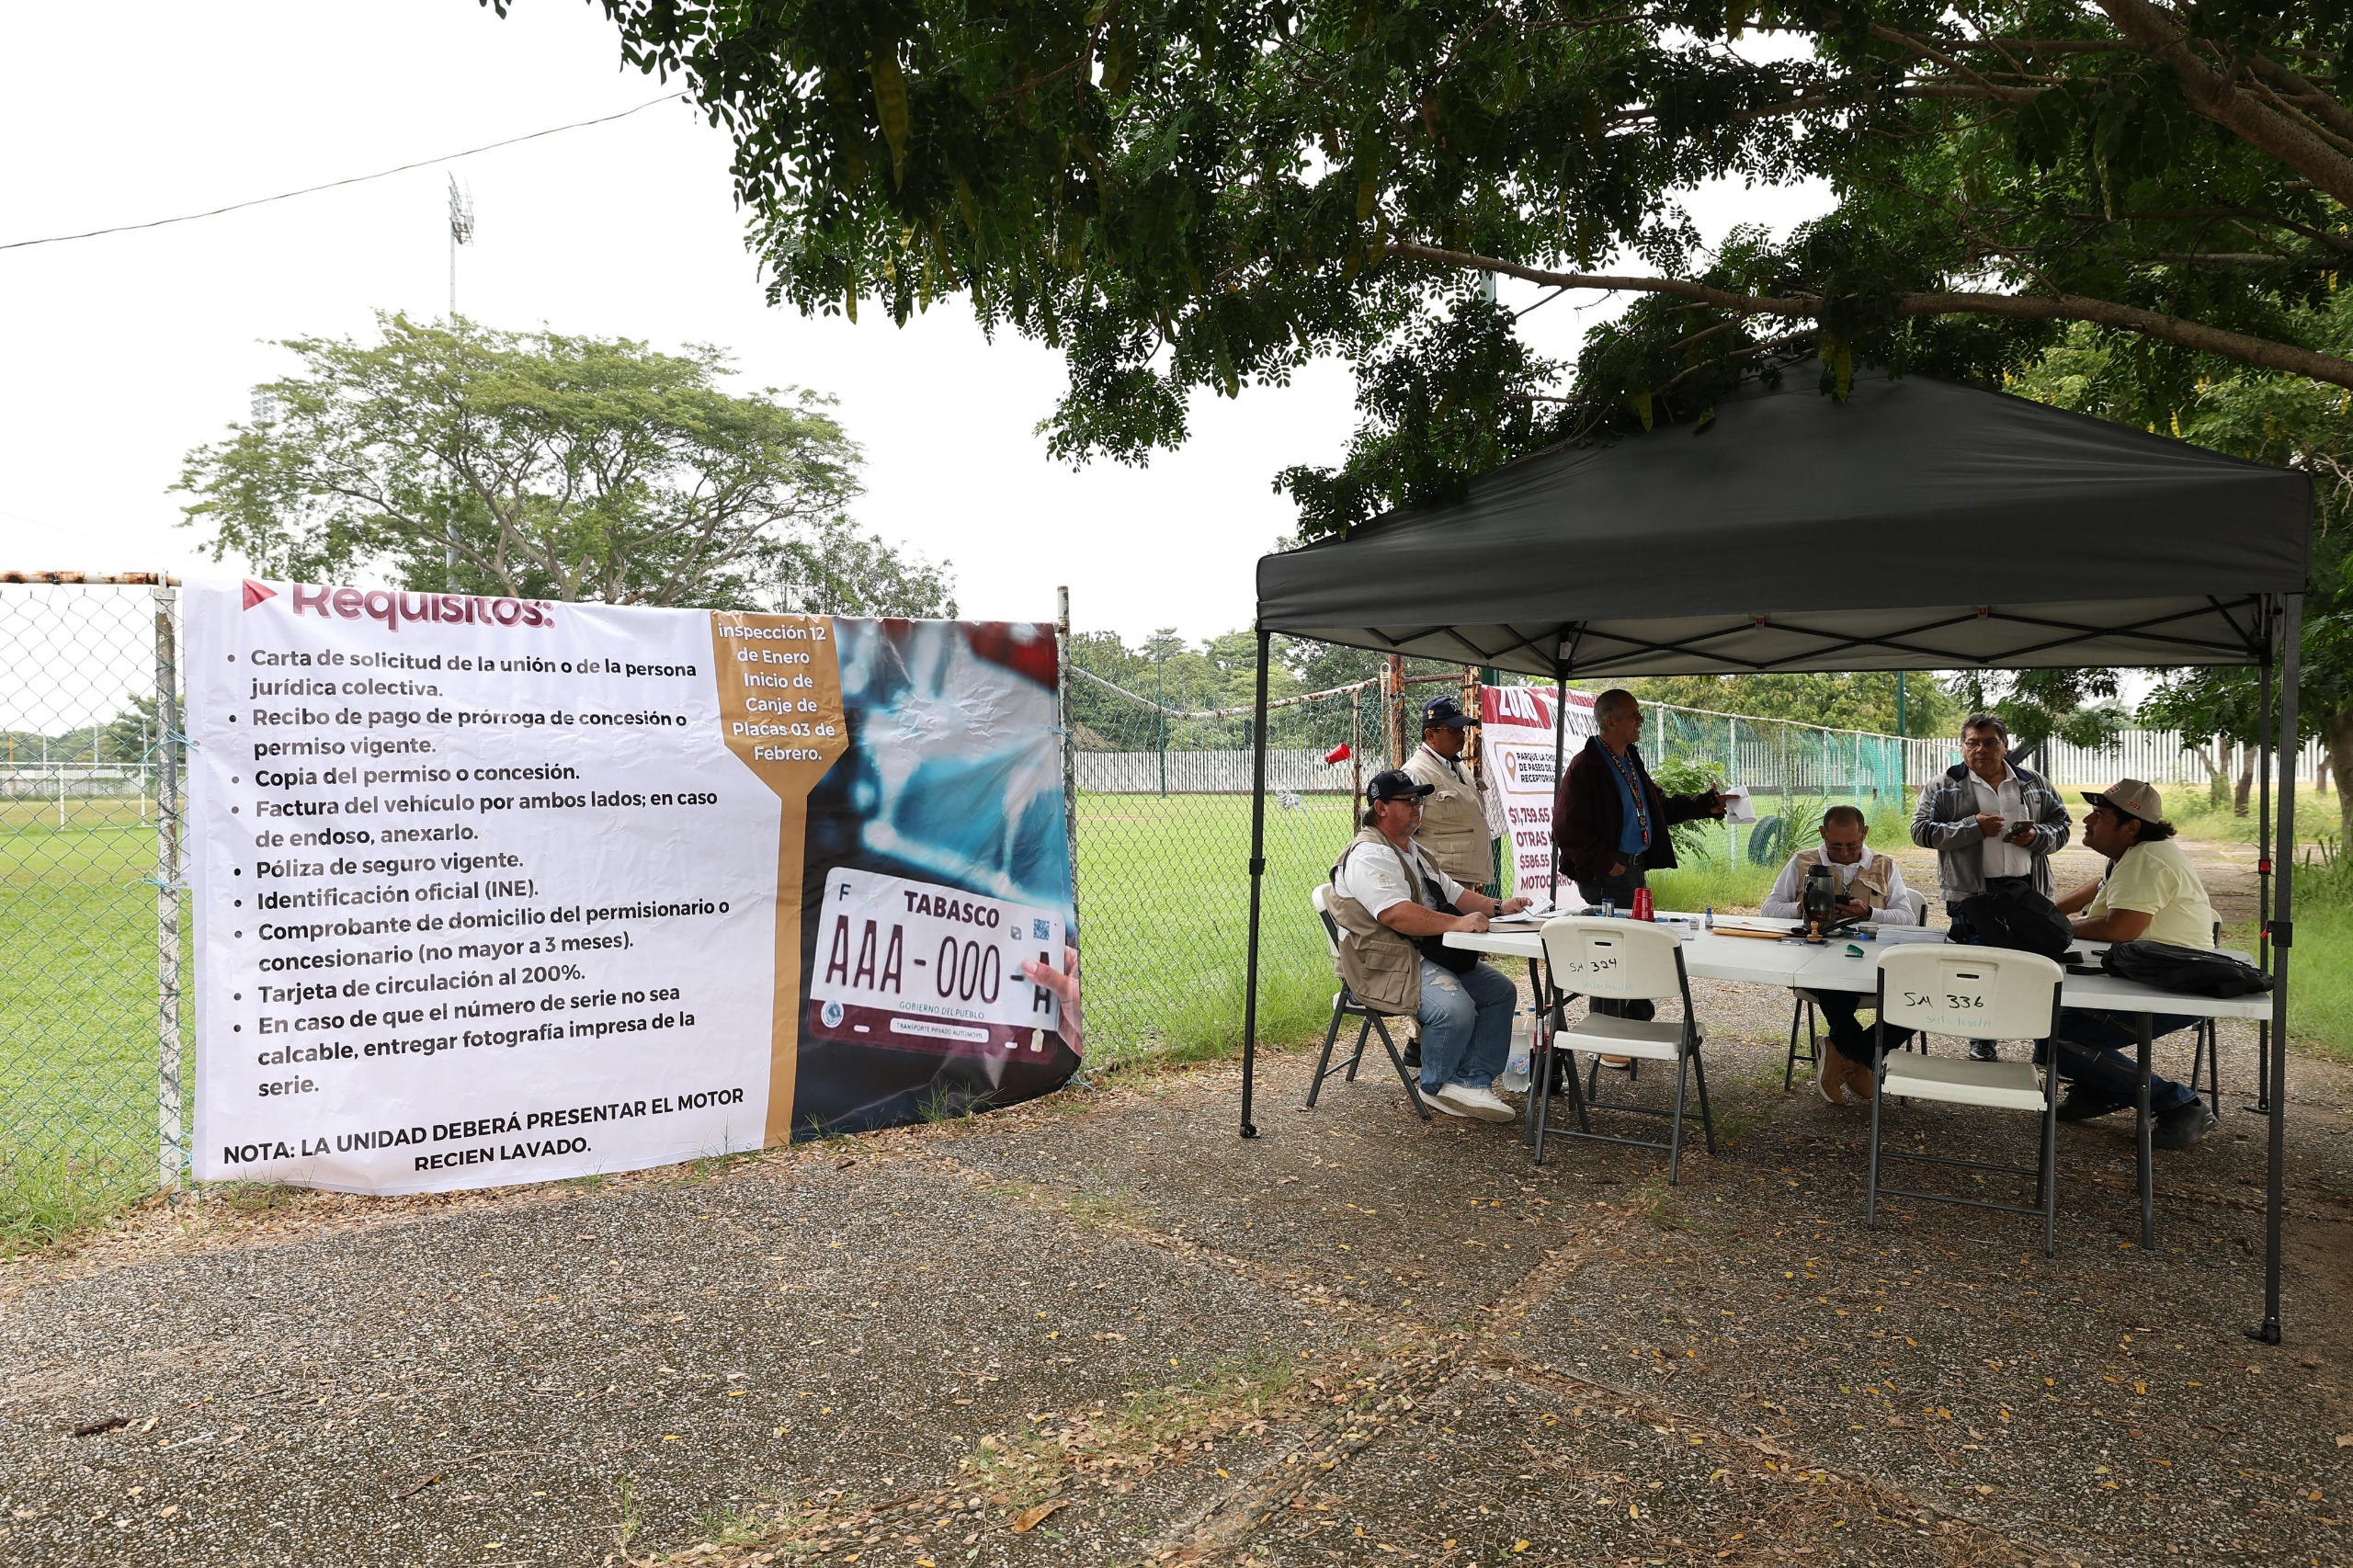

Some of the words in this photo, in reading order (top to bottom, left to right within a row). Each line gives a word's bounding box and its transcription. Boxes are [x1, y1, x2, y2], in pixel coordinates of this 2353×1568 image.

[292, 584, 555, 632] Requisitos:
[719, 622, 807, 640] inspección
[810, 627, 825, 640] 12
[252, 650, 311, 665] Carta
[317, 649, 344, 665] de
[350, 652, 441, 670] solicitud
[448, 655, 472, 670] de
[478, 656, 494, 671] la
[501, 656, 555, 672] unión
[562, 663, 572, 673] o
[577, 659, 600, 674] de
[606, 658, 620, 673] la
[626, 664, 696, 677] persona
[737, 647, 757, 661] de
[763, 650, 809, 664] Enero
[250, 677, 335, 699] jurídica
[342, 678, 442, 697] colectiva.
[745, 672, 788, 687] Inicio
[793, 674, 813, 687] de
[746, 698, 791, 714] Canje
[798, 699, 816, 711] de
[254, 708, 329, 725] Recibo
[335, 708, 362, 724] de
[369, 711, 421, 728] pago
[426, 708, 452, 723] de
[459, 710, 545, 728] prórroga
[551, 710, 574, 725] de
[579, 710, 671, 725] concesión
[676, 716, 687, 726] o
[733, 722, 787, 735] Placas
[790, 711, 812, 736] 03
[815, 723, 835, 735] de
[255, 737, 345, 760] permiso
[350, 736, 436, 757] vigente.
[755, 745, 822, 760] Febrero.
[1517, 752, 1539, 763] PARQUE
[1539, 753, 1545, 762] LA
[256, 767, 317, 790] Copia
[324, 767, 357, 784] del
[364, 765, 450, 787] permiso
[457, 769, 469, 781] o
[474, 763, 579, 780] concesión.
[1518, 763, 1528, 772] DE
[1528, 763, 1545, 772] PASEO
[1545, 764, 1552, 772] DE
[257, 801, 338, 816] Factura
[345, 796, 378, 813] del
[384, 794, 474, 812] vehículo
[481, 797, 514, 813] por
[519, 792, 585, 809] ambos
[592, 790, 645, 807] lados;
[651, 794, 673, 805] en
[677, 793, 717, 804] caso
[1508, 806, 1551, 826] $1,759.65
[256, 830, 284, 847] de
[290, 828, 374, 846] endoso,
[381, 824, 478, 843] anexarlo.
[1516, 831, 1548, 847] OTRAS
[257, 858, 324, 879] Póliza
[330, 858, 357, 875] de
[363, 858, 436, 876] seguro
[441, 852, 523, 873] vigente.
[1519, 853, 1550, 871] $586.55
[839, 883, 851, 902] F
[1520, 873, 1572, 891] MOTOCRRO
[258, 885, 409, 909] Identificación
[415, 881, 478, 901] oficial
[485, 880, 538, 900] (INE).
[259, 917, 411, 942] Comprobante
[417, 914, 443, 931] de
[449, 907, 545, 928] domicilio
[551, 906, 580, 923] del
[586, 898, 714, 925] permisionario
[719, 902, 729, 913] o
[904, 890, 1000, 929] TABASCO
[259, 945, 413, 971] concesionario
[419, 944, 452, 963] (no
[459, 942, 524, 960] mayor
[529, 941, 540, 953] a
[545, 937, 555, 952] 3
[562, 931, 633, 951] meses).
[1590, 958, 1617, 972] 324
[258, 983, 336, 1005] Tarjeta
[343, 980, 369, 997] de
[376, 971, 493, 994] circulación
[499, 968, 516, 985] al
[522, 964, 585, 983] 200%.
[259, 1017, 288, 1034] En
[295, 1016, 345, 1031] caso
[350, 1010, 377, 1027] de
[383, 1010, 424, 1028] que
[429, 1003, 447, 1020] el
[455, 1000, 535, 1018] número
[540, 994, 565, 1011] de
[571, 989, 616, 1008] serie
[622, 991, 644, 1004] no
[650, 988, 679, 1002] sea
[900, 1001, 939, 1015] GOBIERNO
[941, 1007, 954, 1017] DEL
[955, 1008, 985, 1020] PUEBLO
[1946, 994, 1984, 1008] 336
[258, 1042, 358, 1065] calcable,
[364, 1037, 457, 1056] entregar
[462, 1023, 563, 1048] fotografía
[570, 1019, 646, 1039] impresa
[652, 1013, 675, 1028] de
[680, 1011, 694, 1027] la
[896, 1022, 930, 1033] TRANSPORTE
[931, 1027, 952, 1036] PRIVADO
[259, 1075, 319, 1096] serie.
[224, 1142, 294, 1164] NOTA:
[302, 1138, 331, 1156] LA
[337, 1128, 426, 1152] UNIDAD
[433, 1111, 521, 1141] DEBERÁ
[528, 1101, 646, 1130] PRESENTAR
[653, 1097, 673, 1114] EL
[678, 1088, 743, 1110] MOTOR
[415, 1147, 494, 1171] RECIEN
[501, 1137, 591, 1160] LAVADO.
